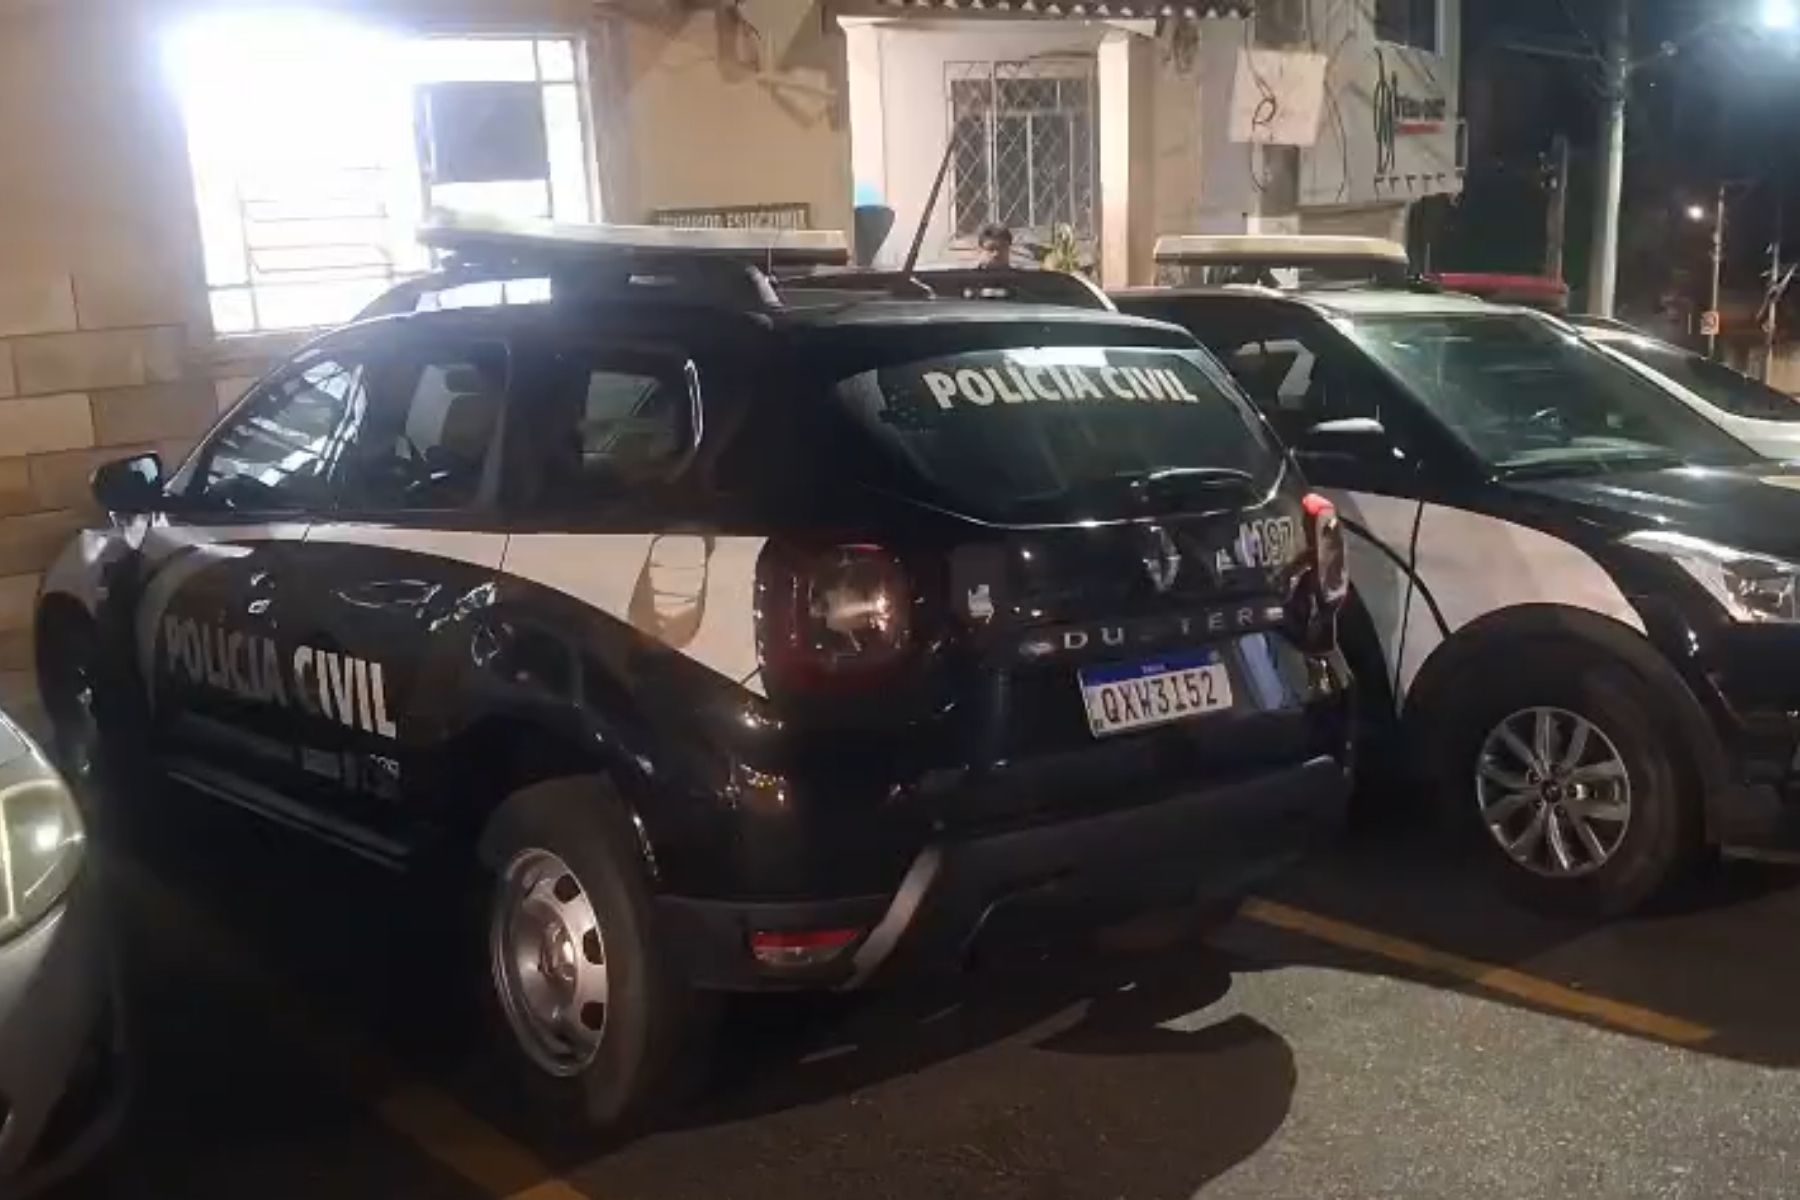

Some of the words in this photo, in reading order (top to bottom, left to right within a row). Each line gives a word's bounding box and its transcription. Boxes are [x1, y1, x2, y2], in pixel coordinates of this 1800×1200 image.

[1101, 366, 1199, 403] CIVIL
[1063, 608, 1253, 650] DUTER
[294, 645, 396, 740] CIVIL
